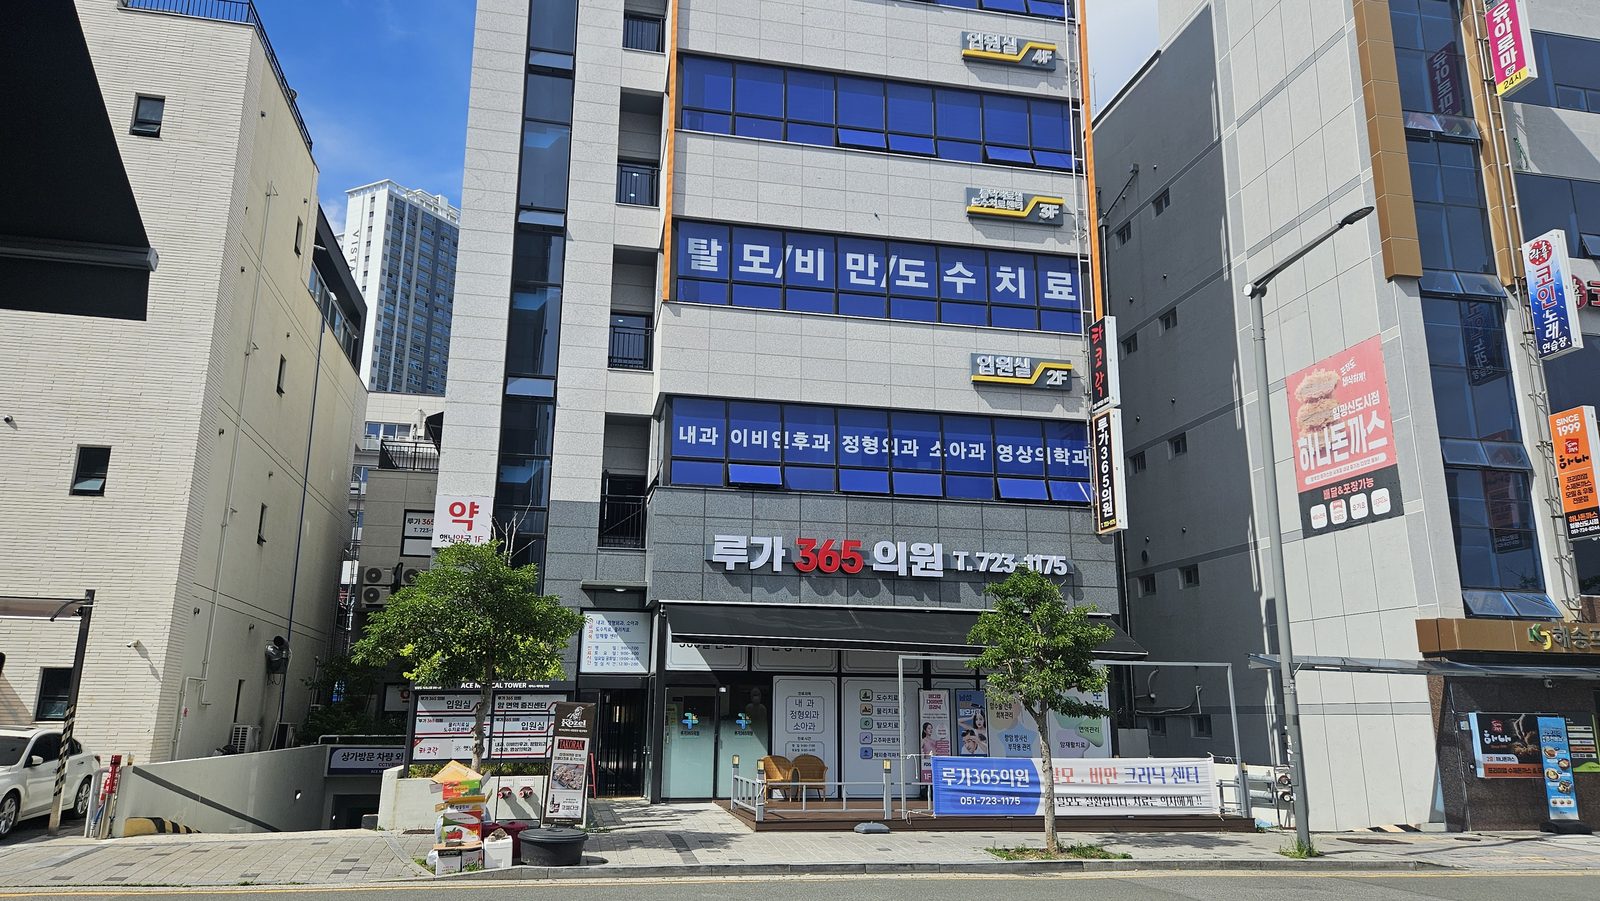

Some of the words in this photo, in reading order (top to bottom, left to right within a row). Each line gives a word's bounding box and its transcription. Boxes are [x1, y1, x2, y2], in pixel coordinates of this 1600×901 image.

[967, 32, 1018, 55] 입원실
[1493, 3, 1517, 69] 유아로마
[1032, 50, 1053, 64] 4F
[1506, 66, 1514, 75] 3F
[1503, 72, 1522, 89] 24시
[1039, 203, 1060, 220] 3F
[348, 230, 360, 272] VISTA
[1542, 336, 1567, 353] 연습장
[976, 355, 1031, 378] 입원실
[1046, 369, 1067, 386] 2F
[1332, 390, 1380, 420] 일광신도시점
[1556, 414, 1579, 426] SINCE
[1557, 422, 1581, 437] 1999
[679, 425, 719, 446] 내과
[730, 428, 831, 452] 이비인후과
[842, 434, 919, 458] 정형외과
[929, 440, 986, 460] 소아과
[996, 444, 1090, 467] 영상의학과
[1297, 410, 1388, 471] 하나돈까스
[1097, 416, 1114, 518] 루가365의원
[1322, 477, 1374, 500] 배달&포장가능
[448, 501, 479, 532] 약
[712, 534, 786, 572] 루가
[794, 537, 865, 574] 365
[873, 540, 944, 578] 의원
[953, 550, 973, 572] T.
[446, 700, 471, 709] 입원실
[506, 701, 519, 709] 면역
[520, 701, 547, 709] 증진센터
[876, 694, 899, 702] 도수치료
[560, 718, 587, 728] Kozel
[790, 710, 820, 720] 정형외과
[520, 721, 545, 730] 입원실
[793, 722, 816, 731] 소아과
[559, 739, 584, 750] TAKORAK
[1022, 743, 1031, 752] 관리
[341, 751, 375, 762] 상가방문
[376, 751, 394, 762] 차량
[942, 767, 1030, 788] 루가365의원
[1089, 767, 1118, 785] 비만
[1171, 766, 1200, 784] 센터
[960, 797, 1020, 805] 051-723-1175
